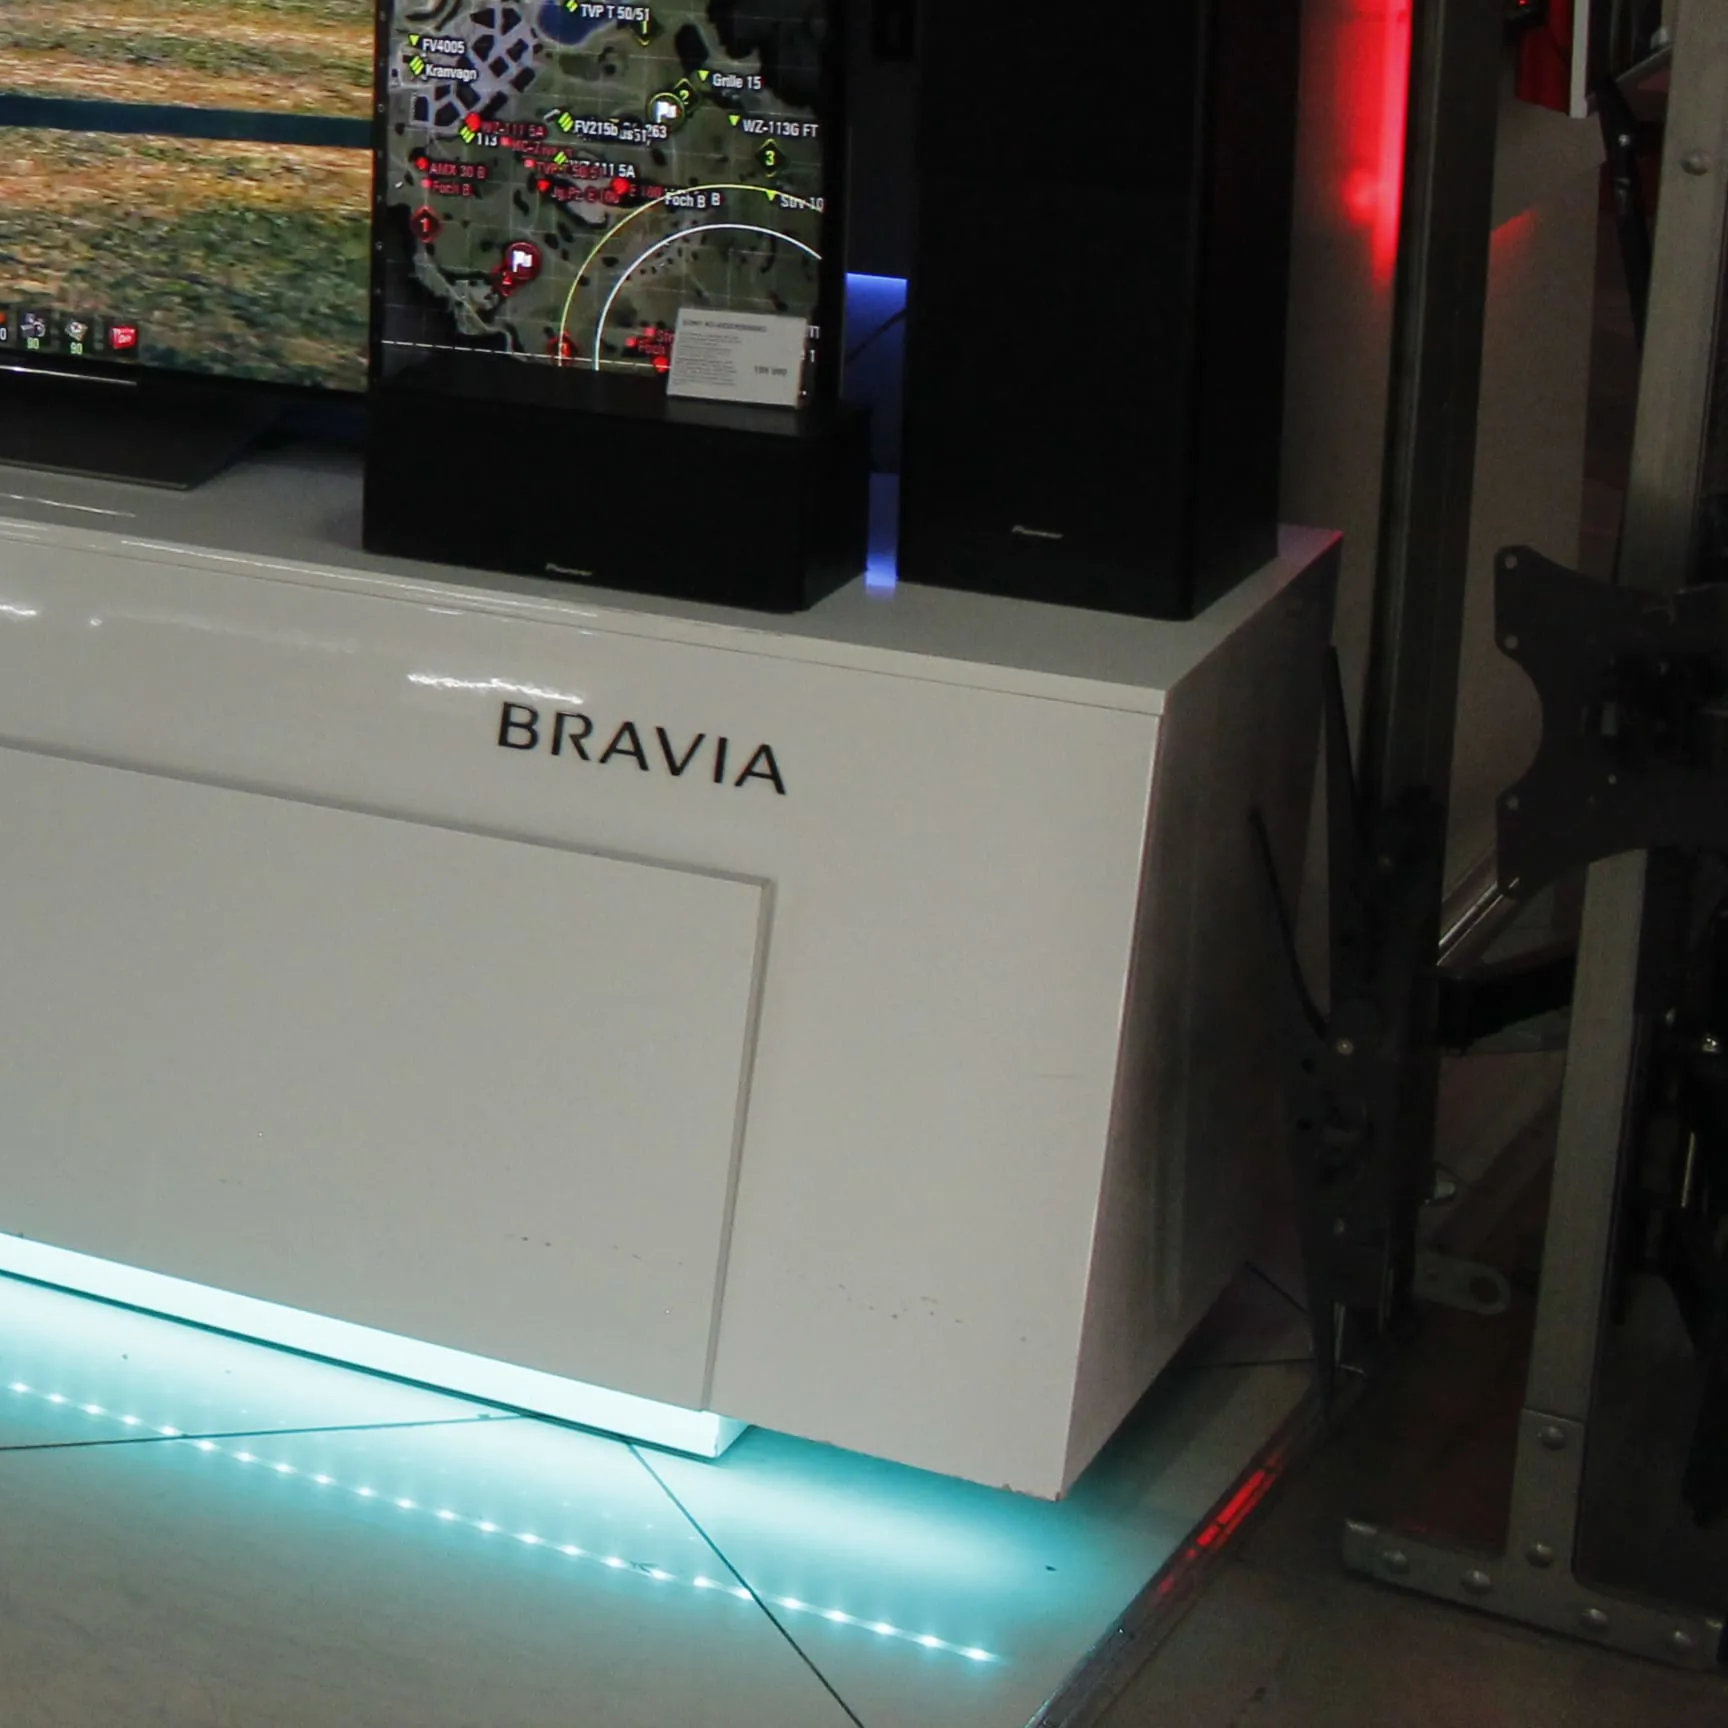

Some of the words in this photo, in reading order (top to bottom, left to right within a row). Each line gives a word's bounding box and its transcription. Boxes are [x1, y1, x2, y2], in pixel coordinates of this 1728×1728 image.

[580, 3, 604, 19] TVP
[616, 5, 651, 22] 50/51
[422, 38, 466, 55] FV4005
[425, 62, 478, 82] Kranvagn
[746, 75, 762, 90] 15
[573, 120, 619, 137] FV215b
[802, 123, 819, 138] FT
[494, 697, 791, 797] BRAVIA
